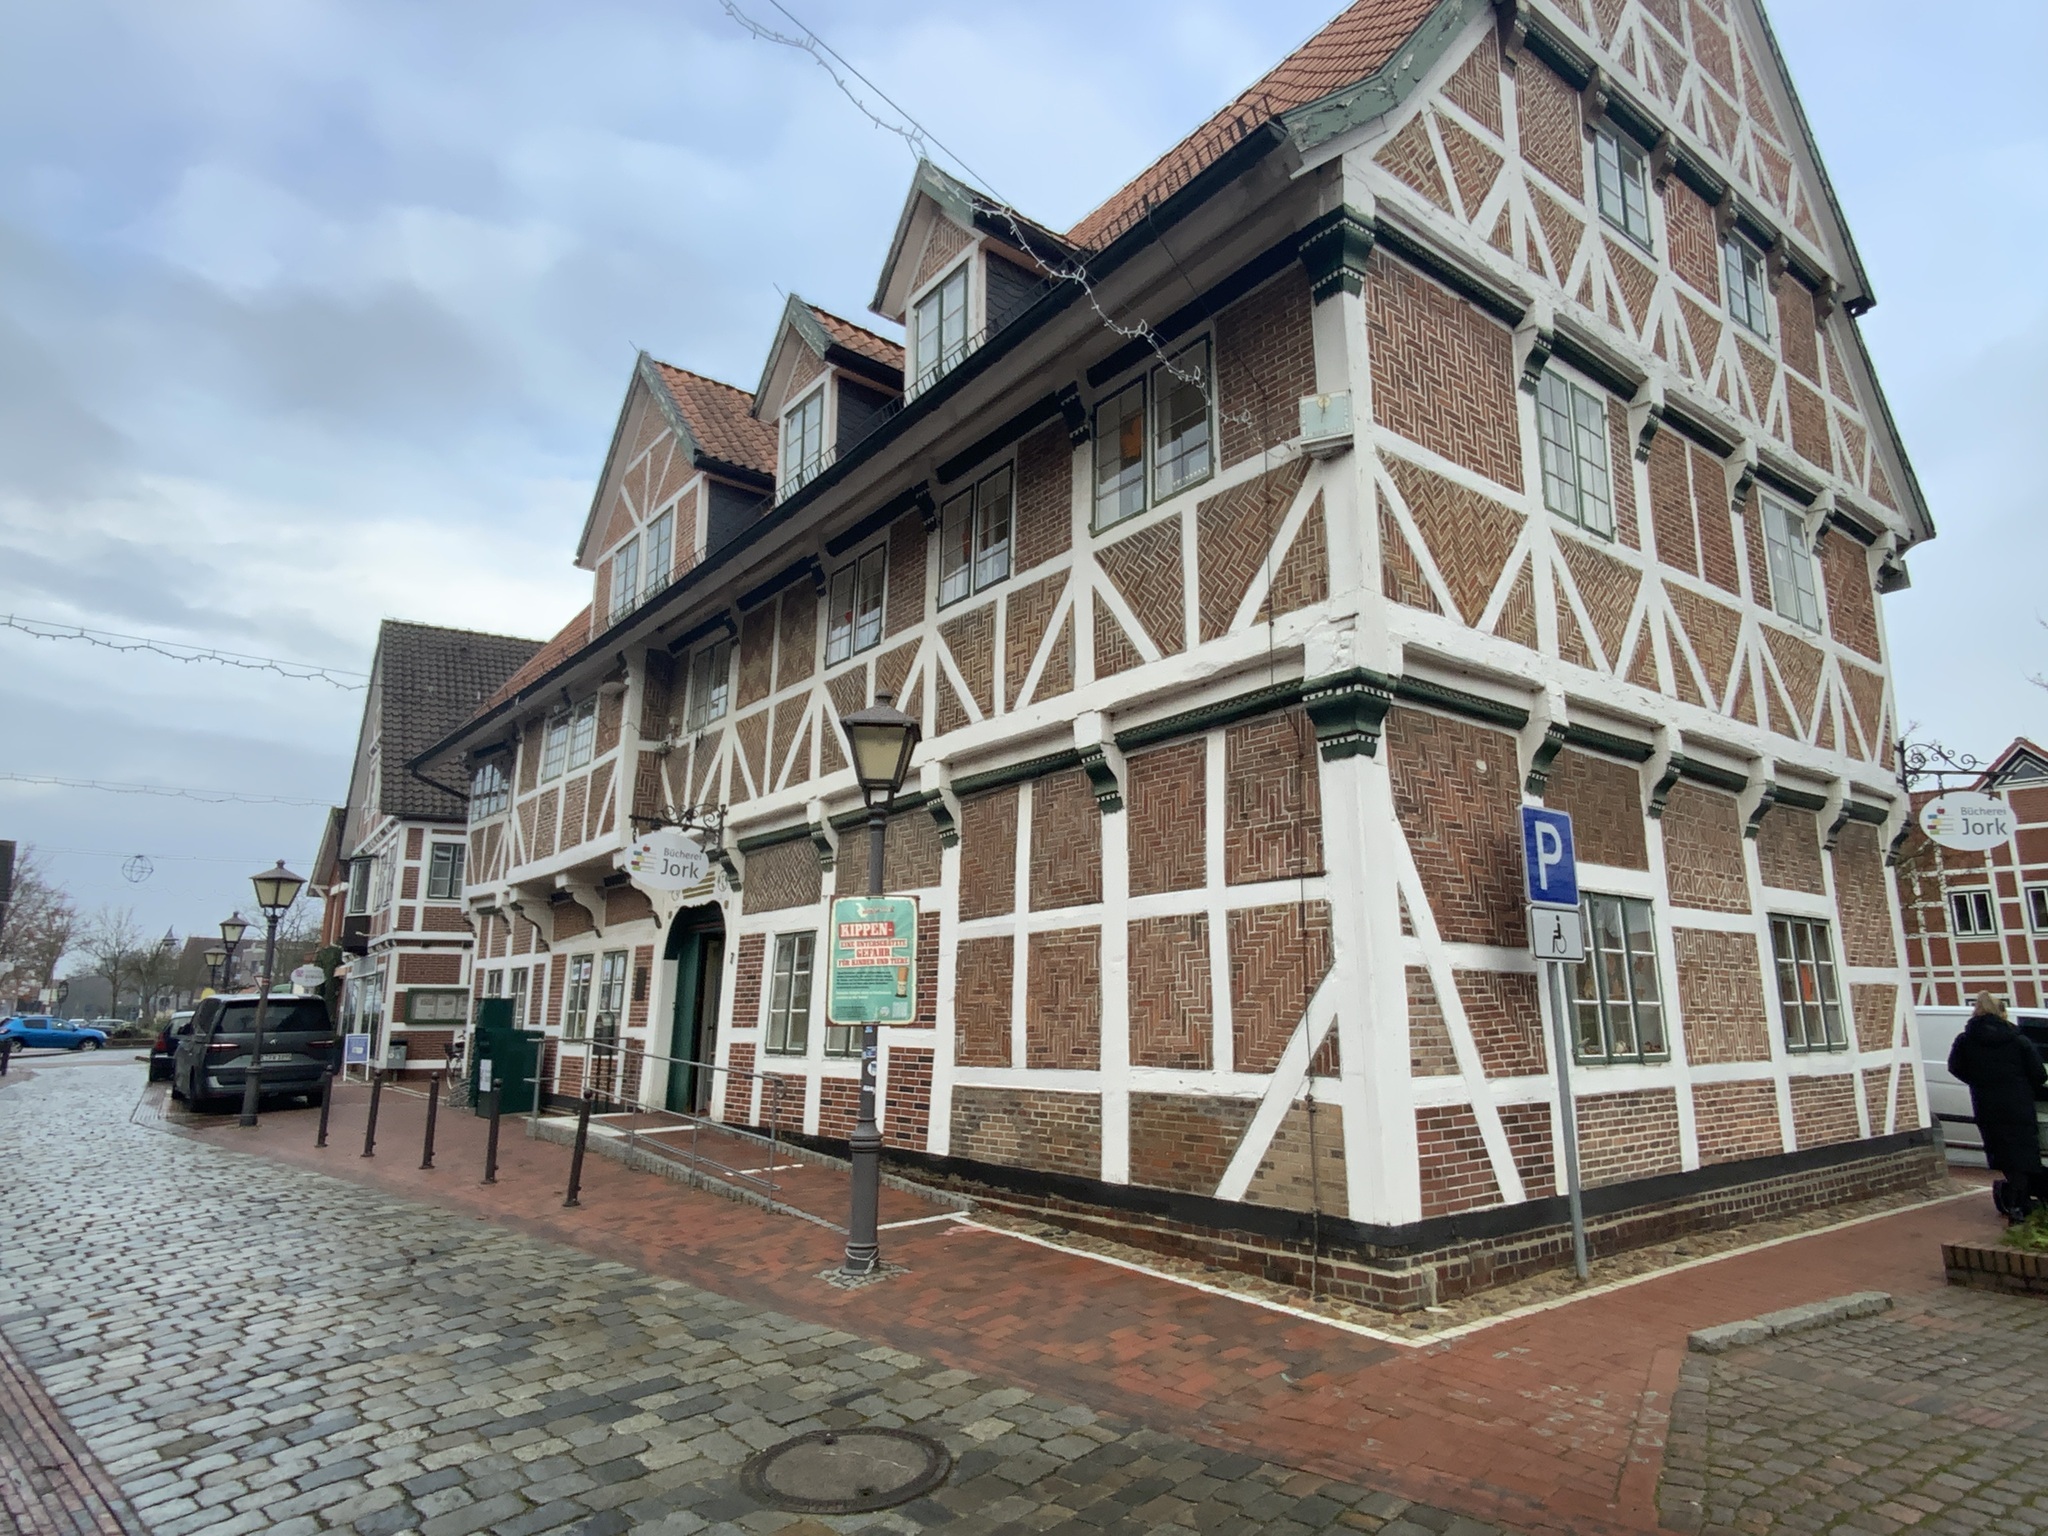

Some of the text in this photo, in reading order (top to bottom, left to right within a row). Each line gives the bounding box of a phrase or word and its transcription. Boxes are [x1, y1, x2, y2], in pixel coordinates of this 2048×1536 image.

[1960, 806, 2007, 816] Bücherei
[1961, 818, 2008, 836] Jork
[663, 848, 703, 860] Bücherei
[1534, 820, 1563, 890] P
[660, 858, 700, 879] Jork
[840, 922, 893, 937] KIPPEN-
[857, 948, 890, 957] GEFAHR
[851, 958, 875, 966] KINDER
